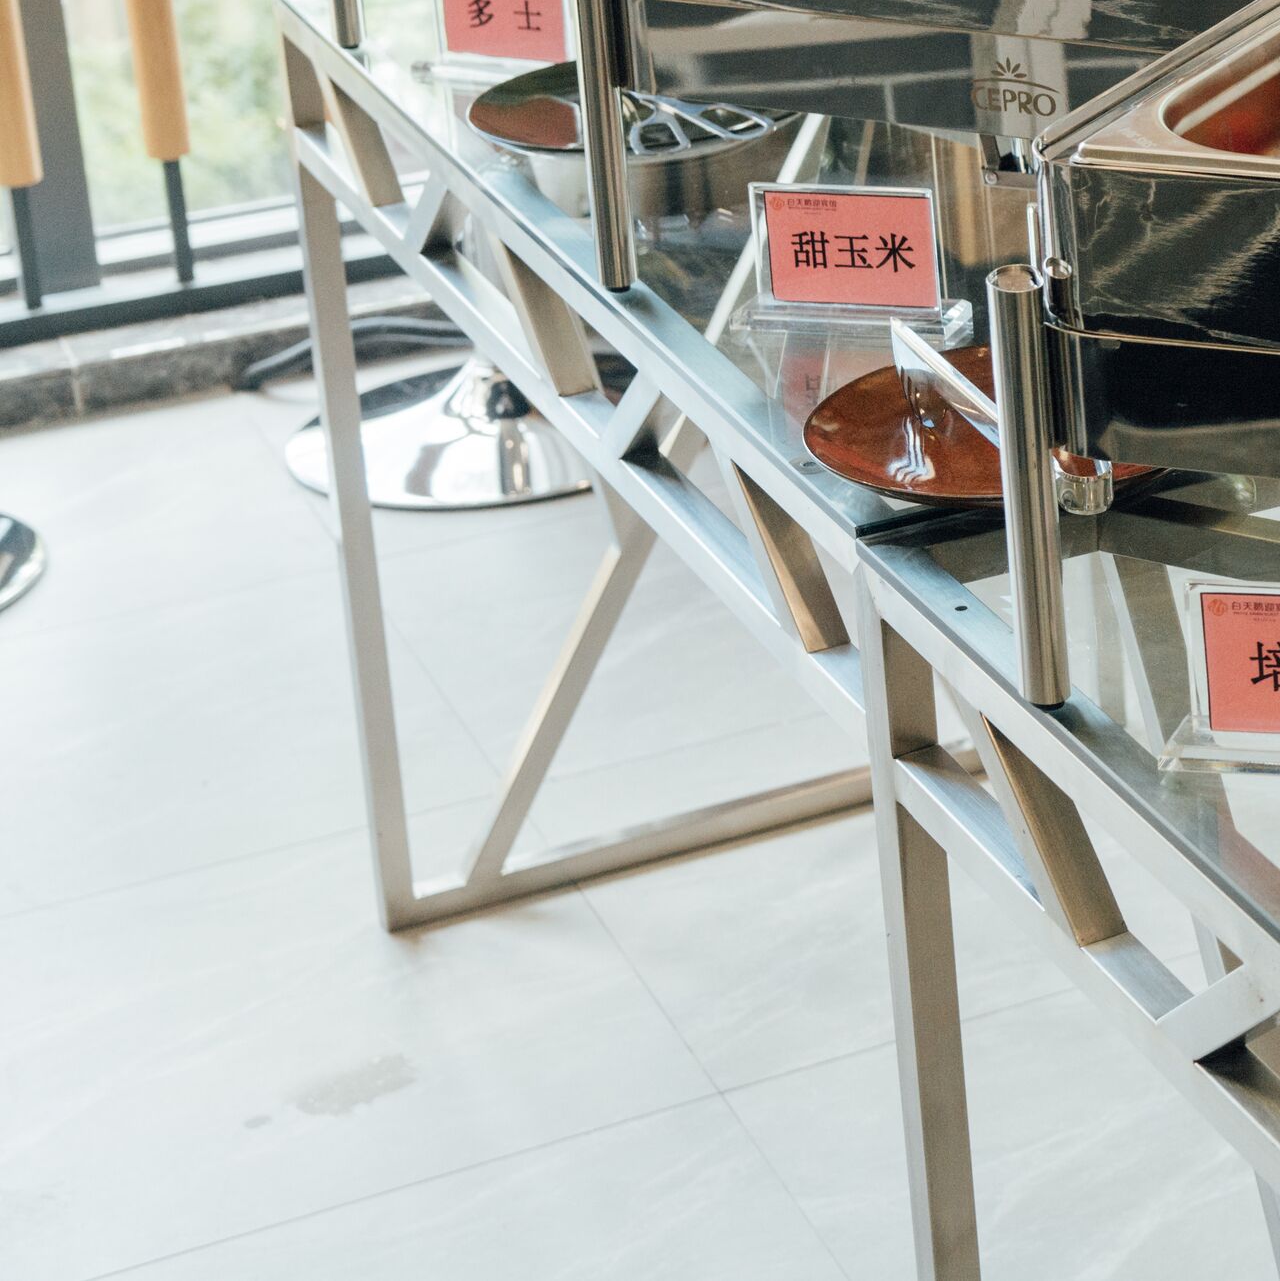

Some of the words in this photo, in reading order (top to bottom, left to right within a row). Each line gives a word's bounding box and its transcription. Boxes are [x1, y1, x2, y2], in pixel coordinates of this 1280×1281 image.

[972, 87, 1056, 116] CEPRO
[791, 231, 916, 273] 甜玉米
